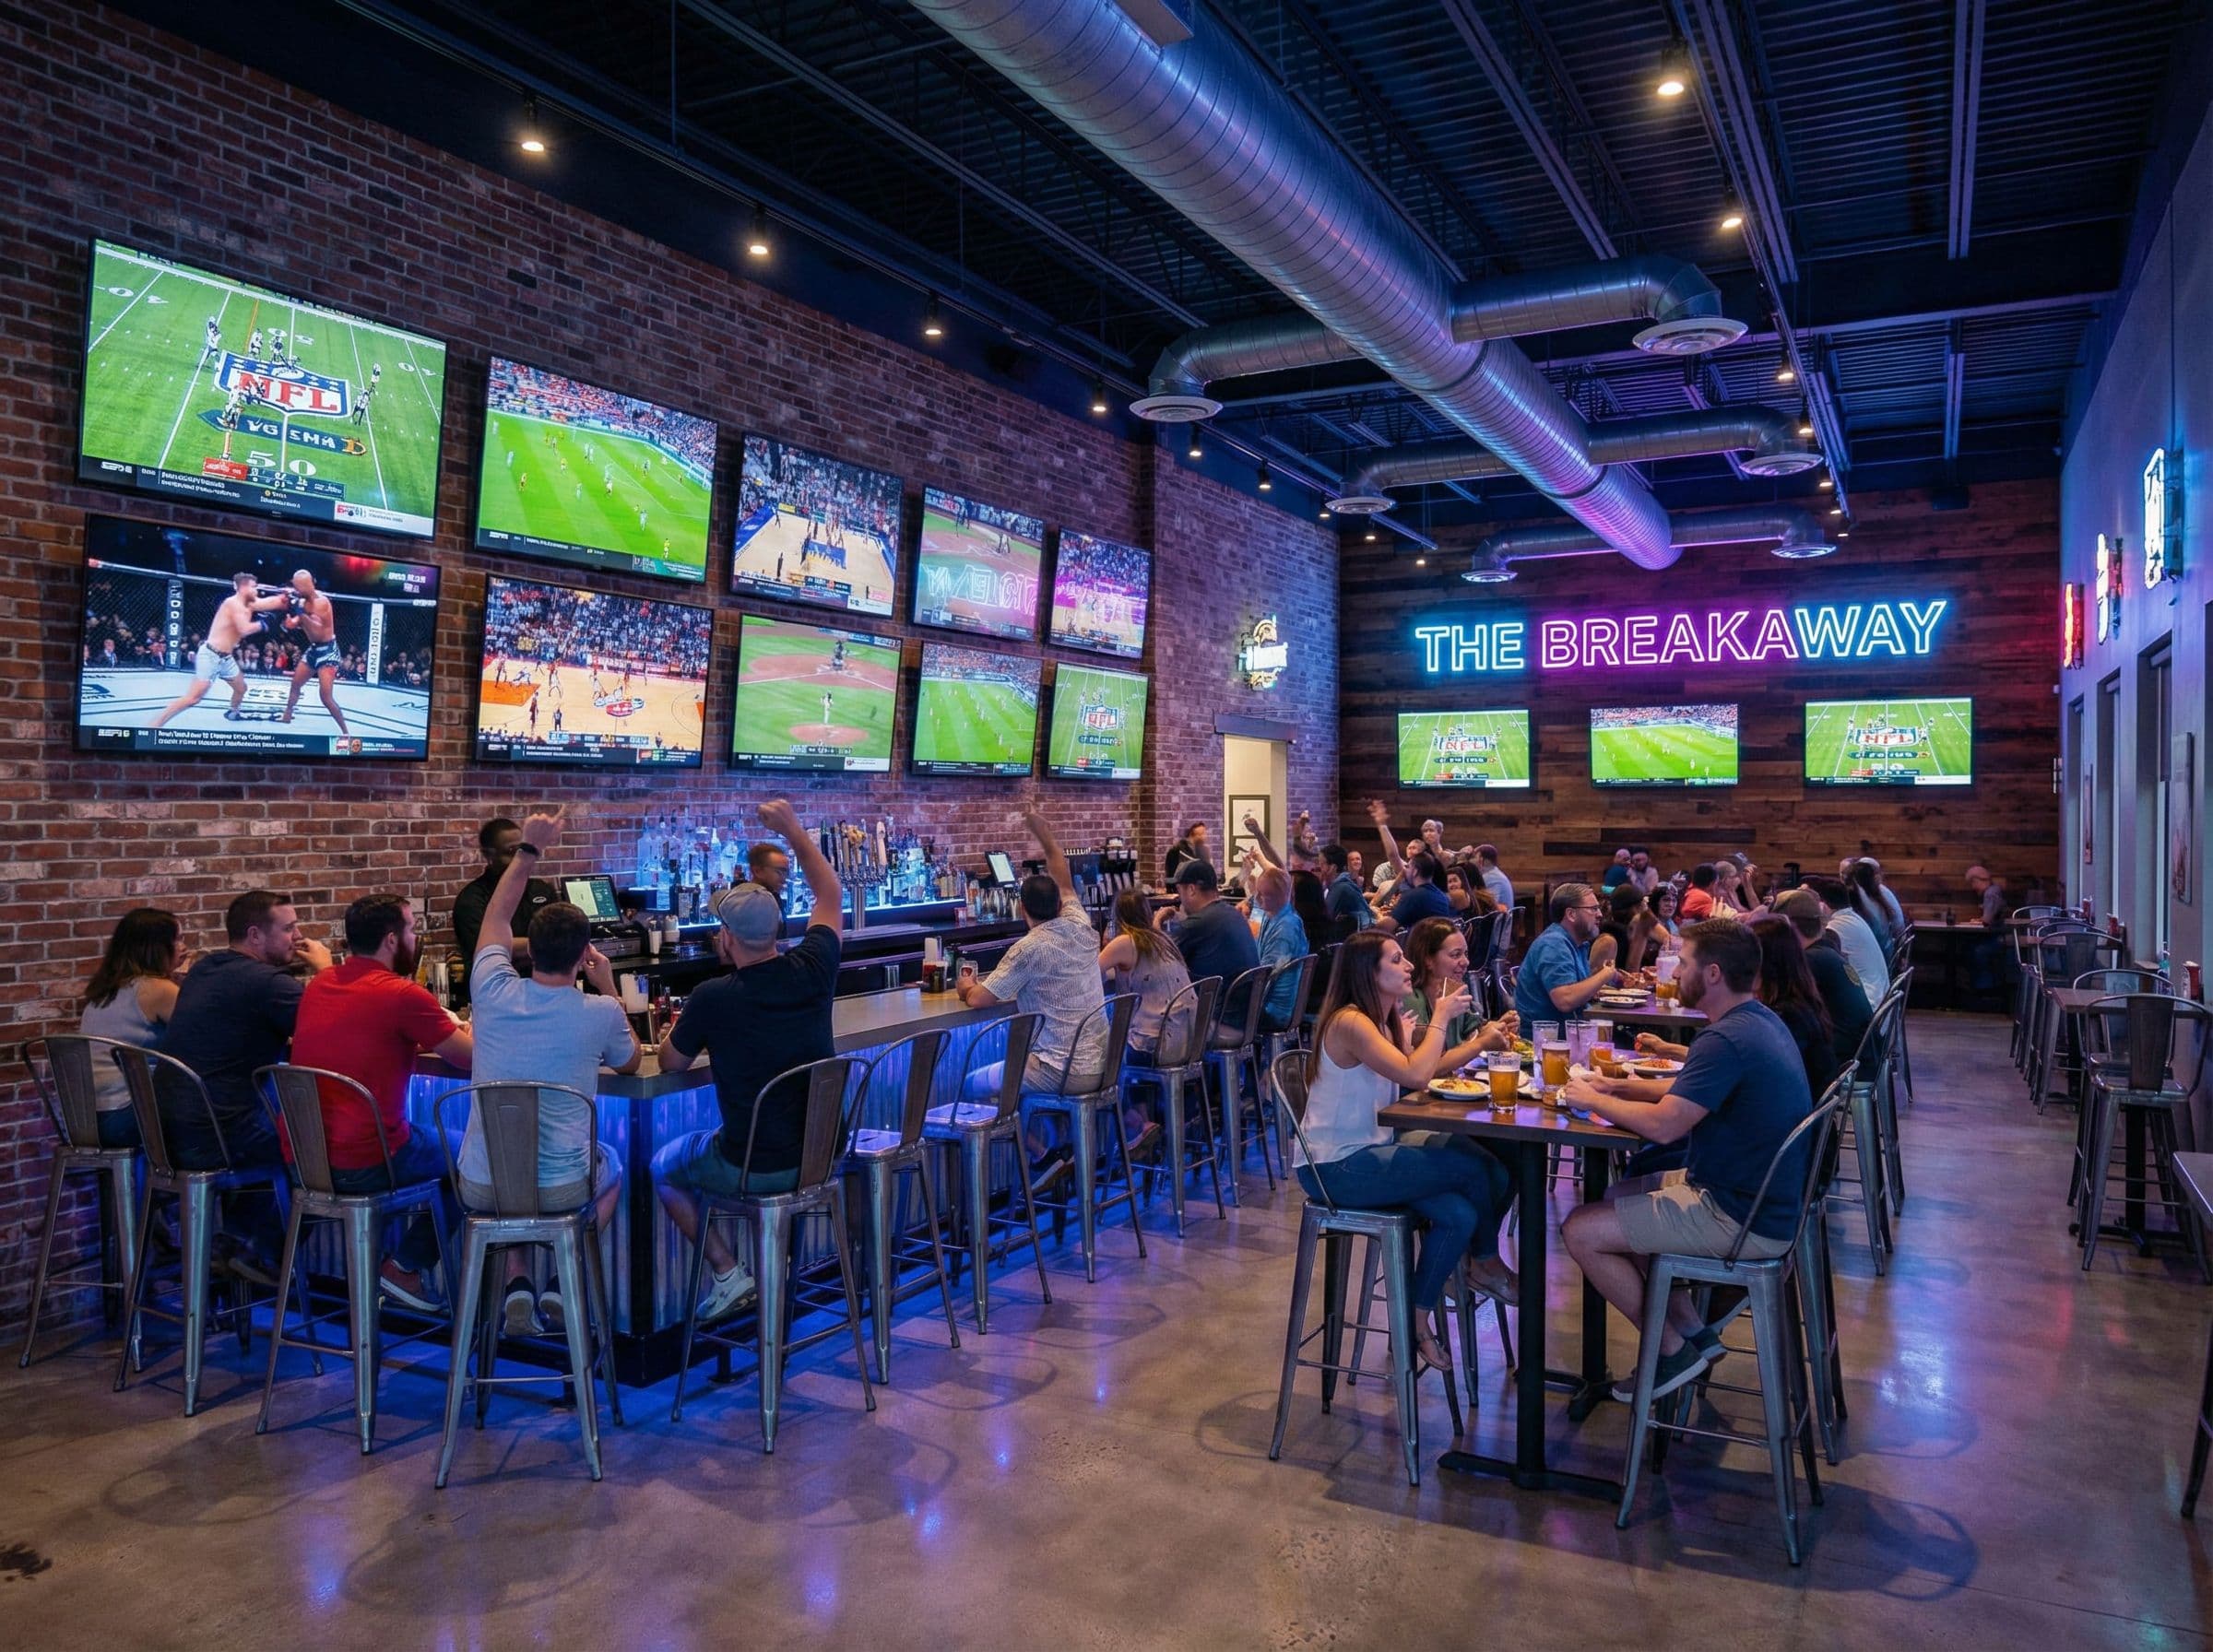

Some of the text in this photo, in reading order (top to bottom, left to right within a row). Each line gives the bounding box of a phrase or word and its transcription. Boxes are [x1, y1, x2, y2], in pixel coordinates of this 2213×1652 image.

[238, 372, 338, 412] NFL
[1414, 600, 1947, 673] THE BREAKAWAY
